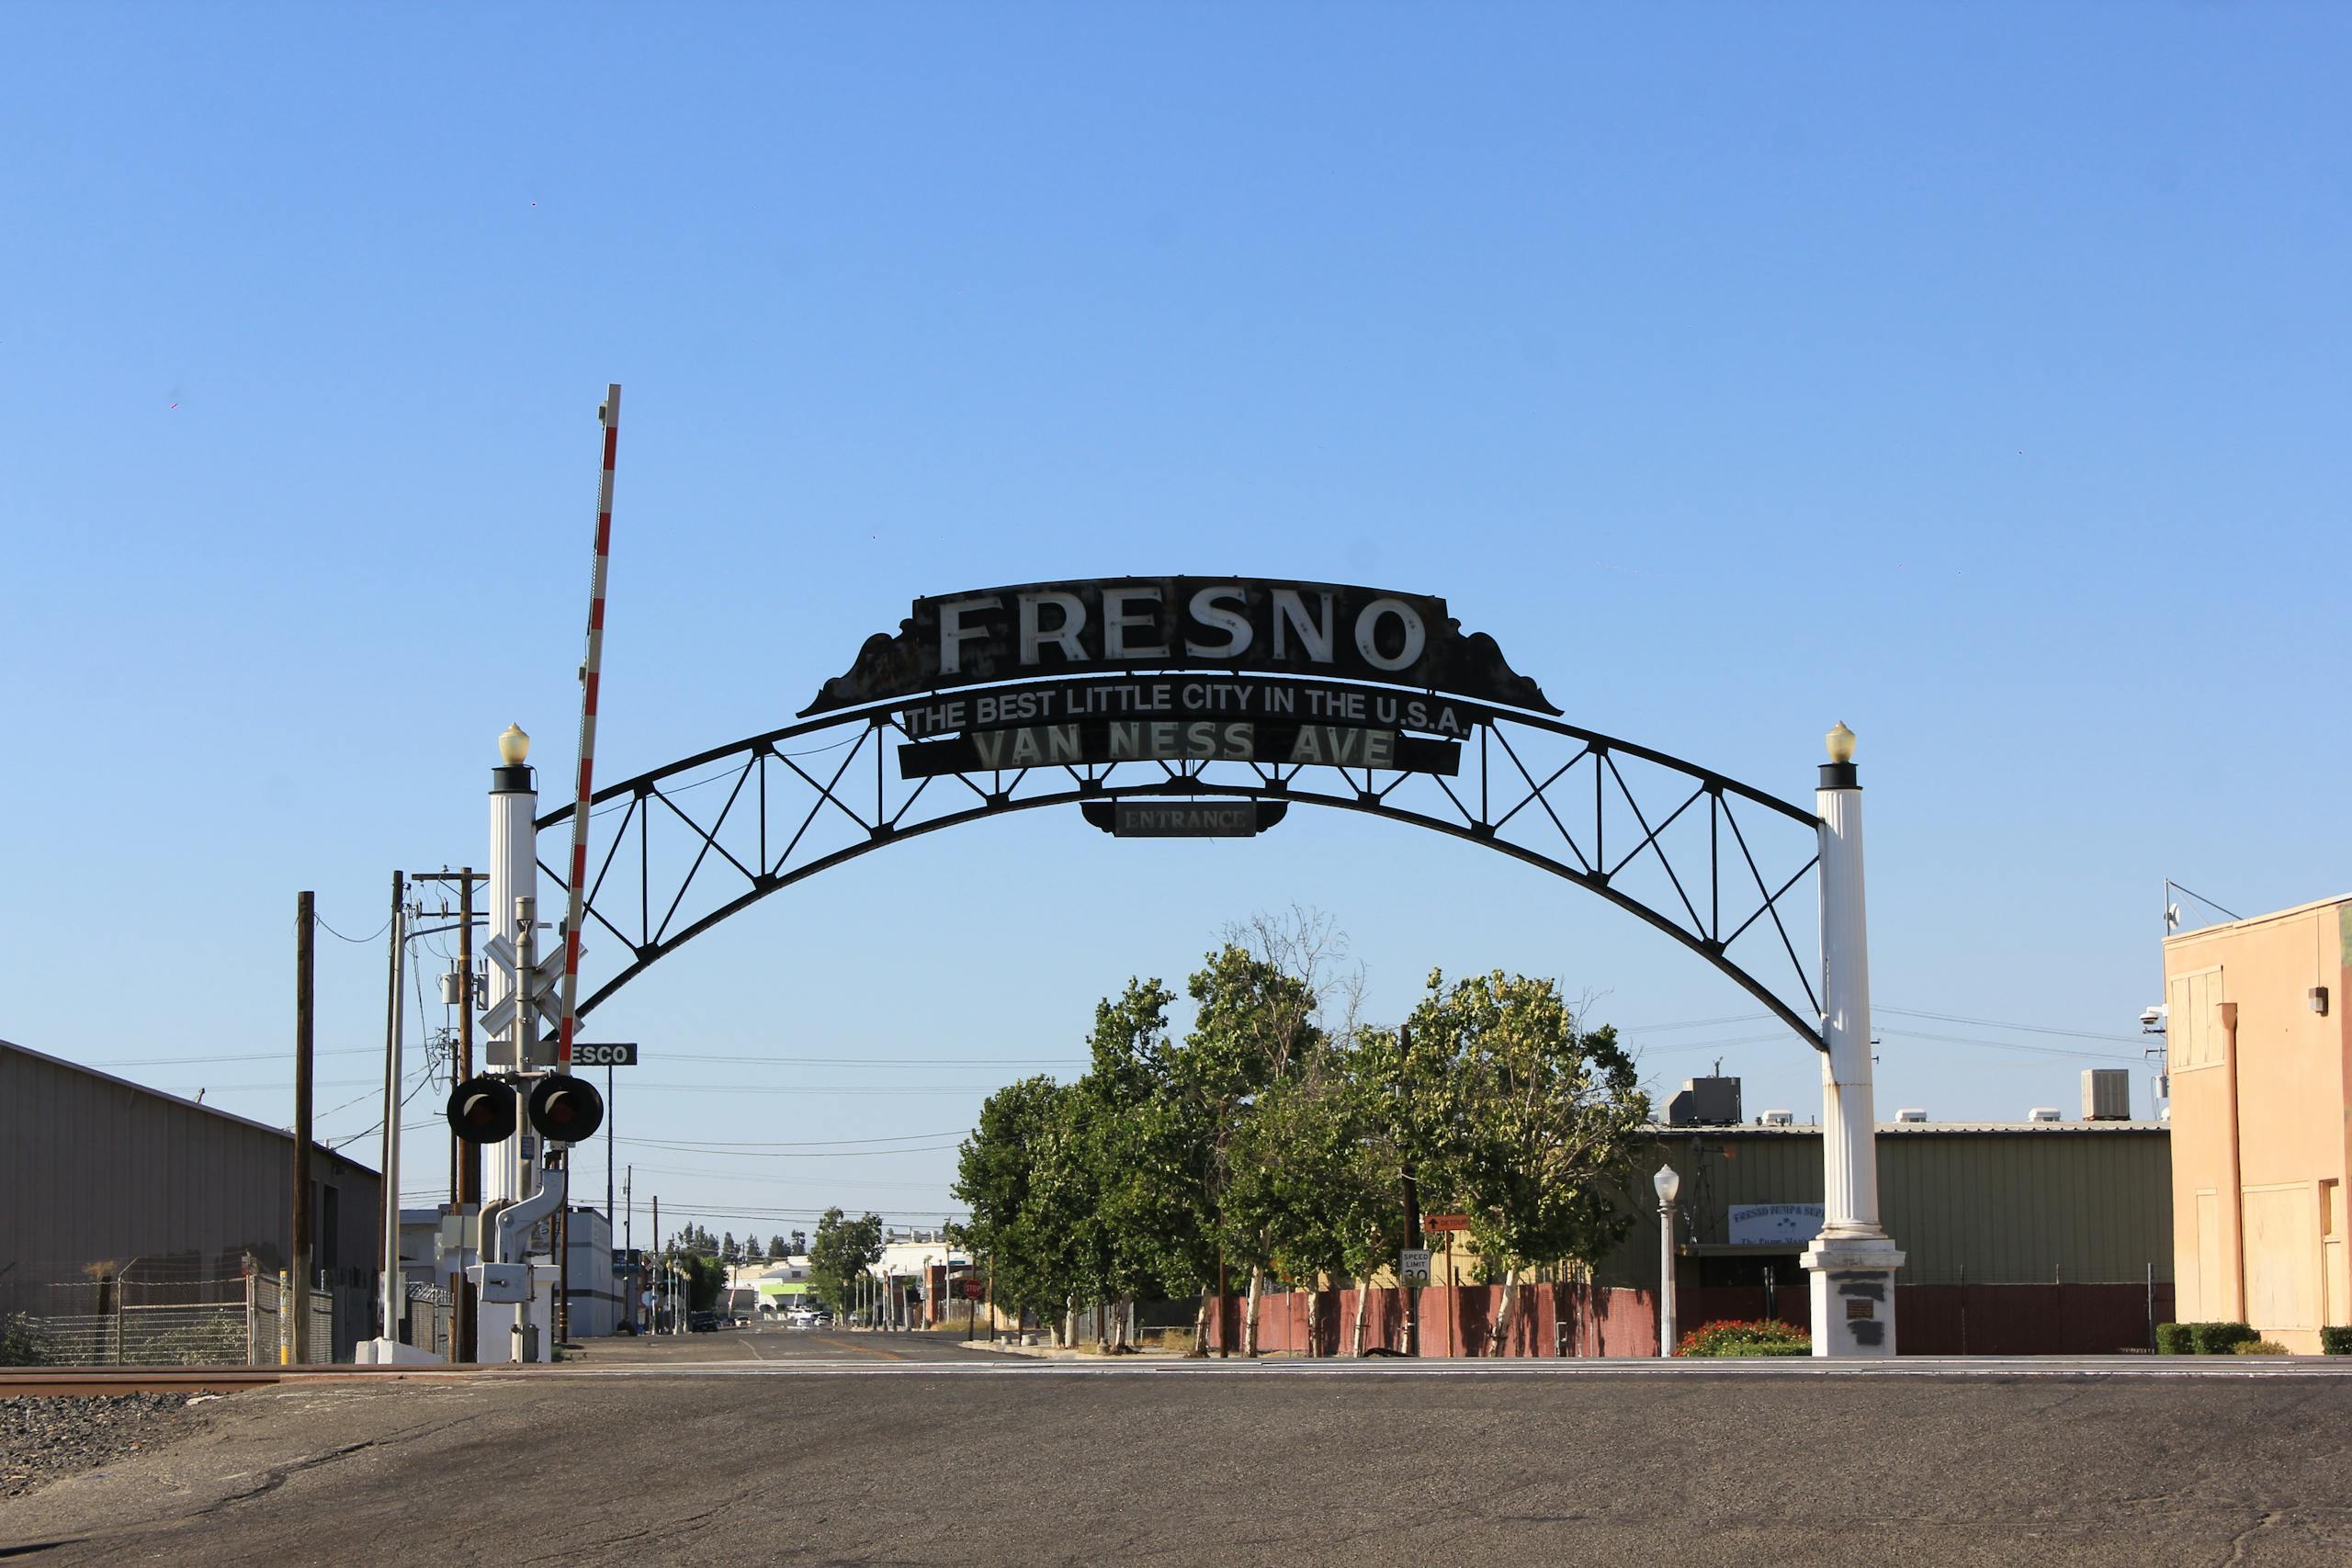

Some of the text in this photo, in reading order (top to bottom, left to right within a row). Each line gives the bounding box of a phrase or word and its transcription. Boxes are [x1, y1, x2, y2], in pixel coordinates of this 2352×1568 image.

[939, 586, 1426, 675] FRESNO
[905, 683, 1469, 735] THE BEST LITTLE CITY IN THE U.S.A.
[971, 721, 1390, 770] VAN NESS AVE
[1125, 810, 1246, 829] ENTRANCE
[1734, 1206, 1769, 1223] FRESNO
